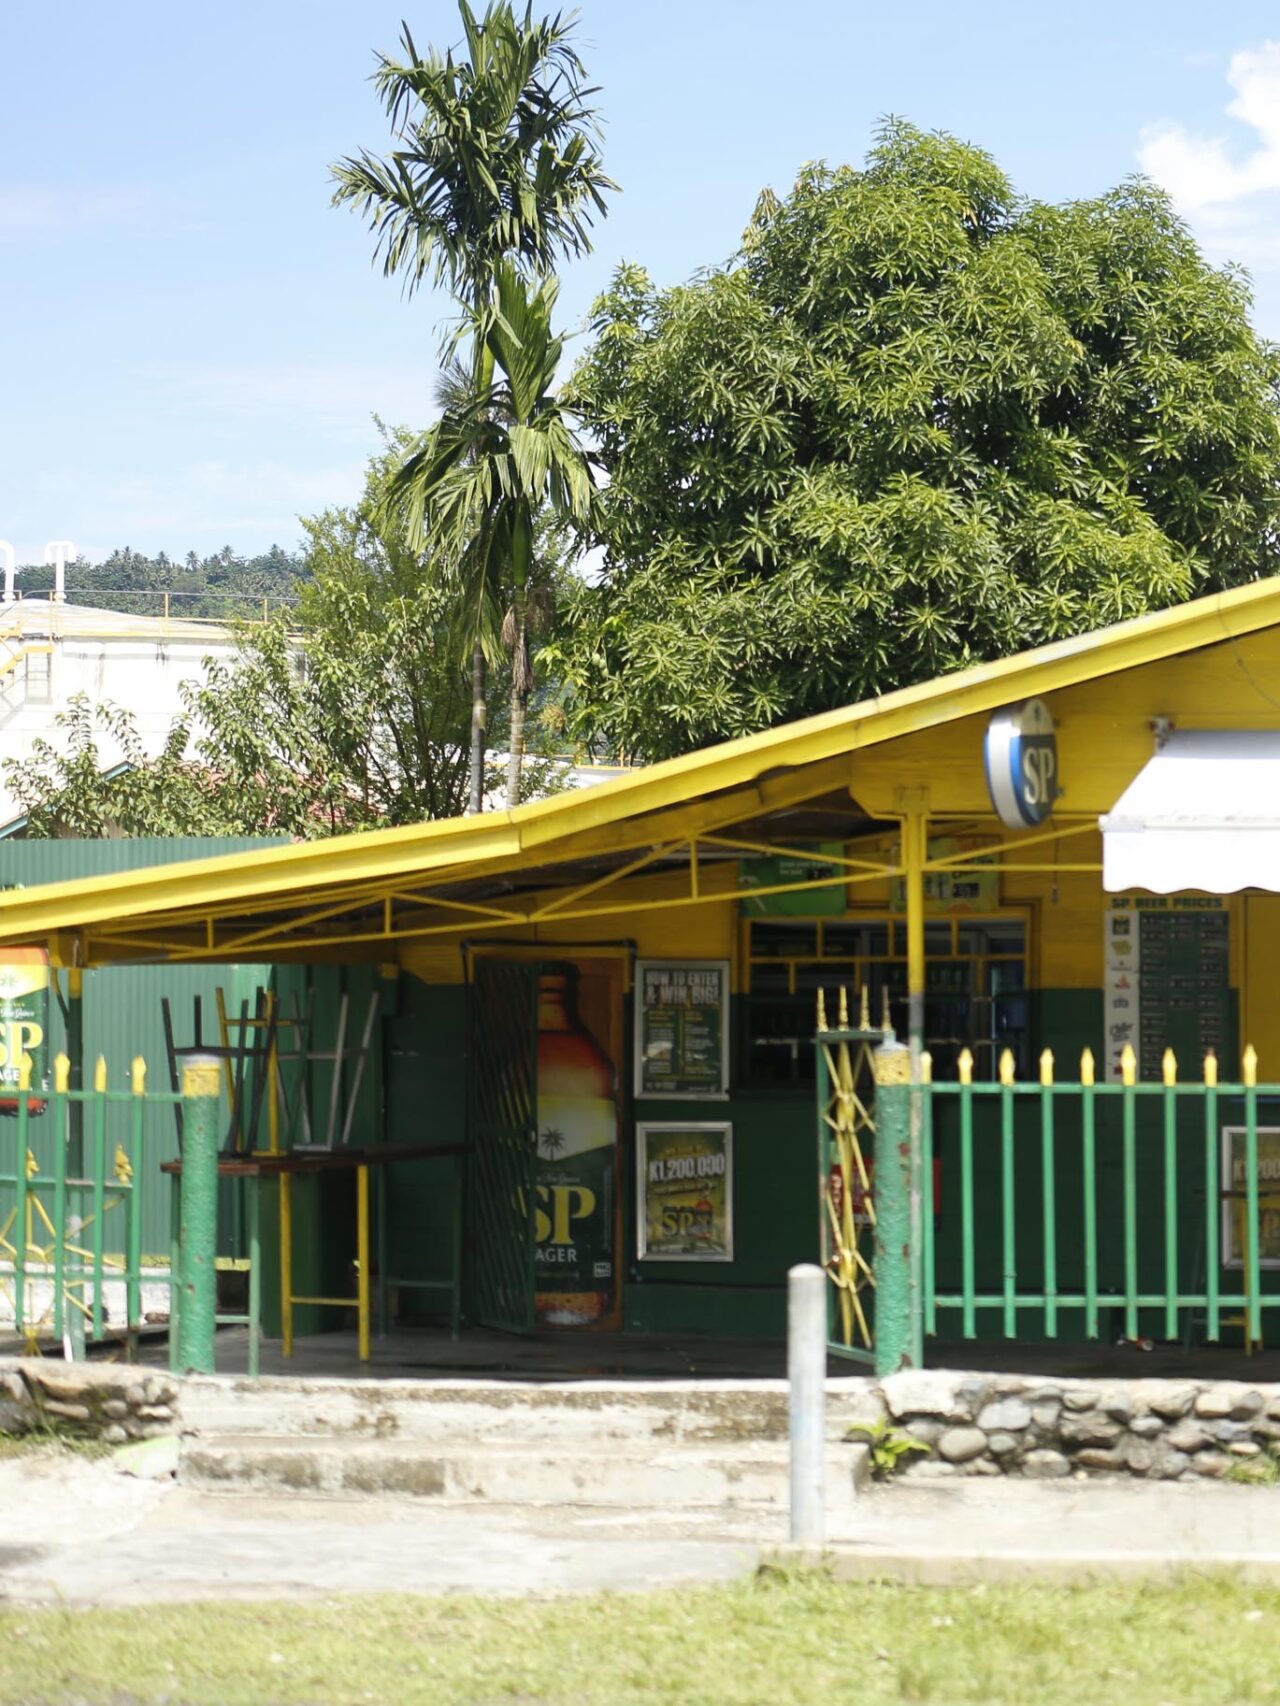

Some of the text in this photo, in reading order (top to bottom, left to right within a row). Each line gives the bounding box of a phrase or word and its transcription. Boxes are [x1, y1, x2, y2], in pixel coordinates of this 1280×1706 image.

[1023, 747, 1054, 804] SP
[660, 986, 687, 1004] WIN
[0, 1021, 43, 1068] P
[662, 1209, 695, 1237] SP
[534, 1247, 577, 1262] AGER
